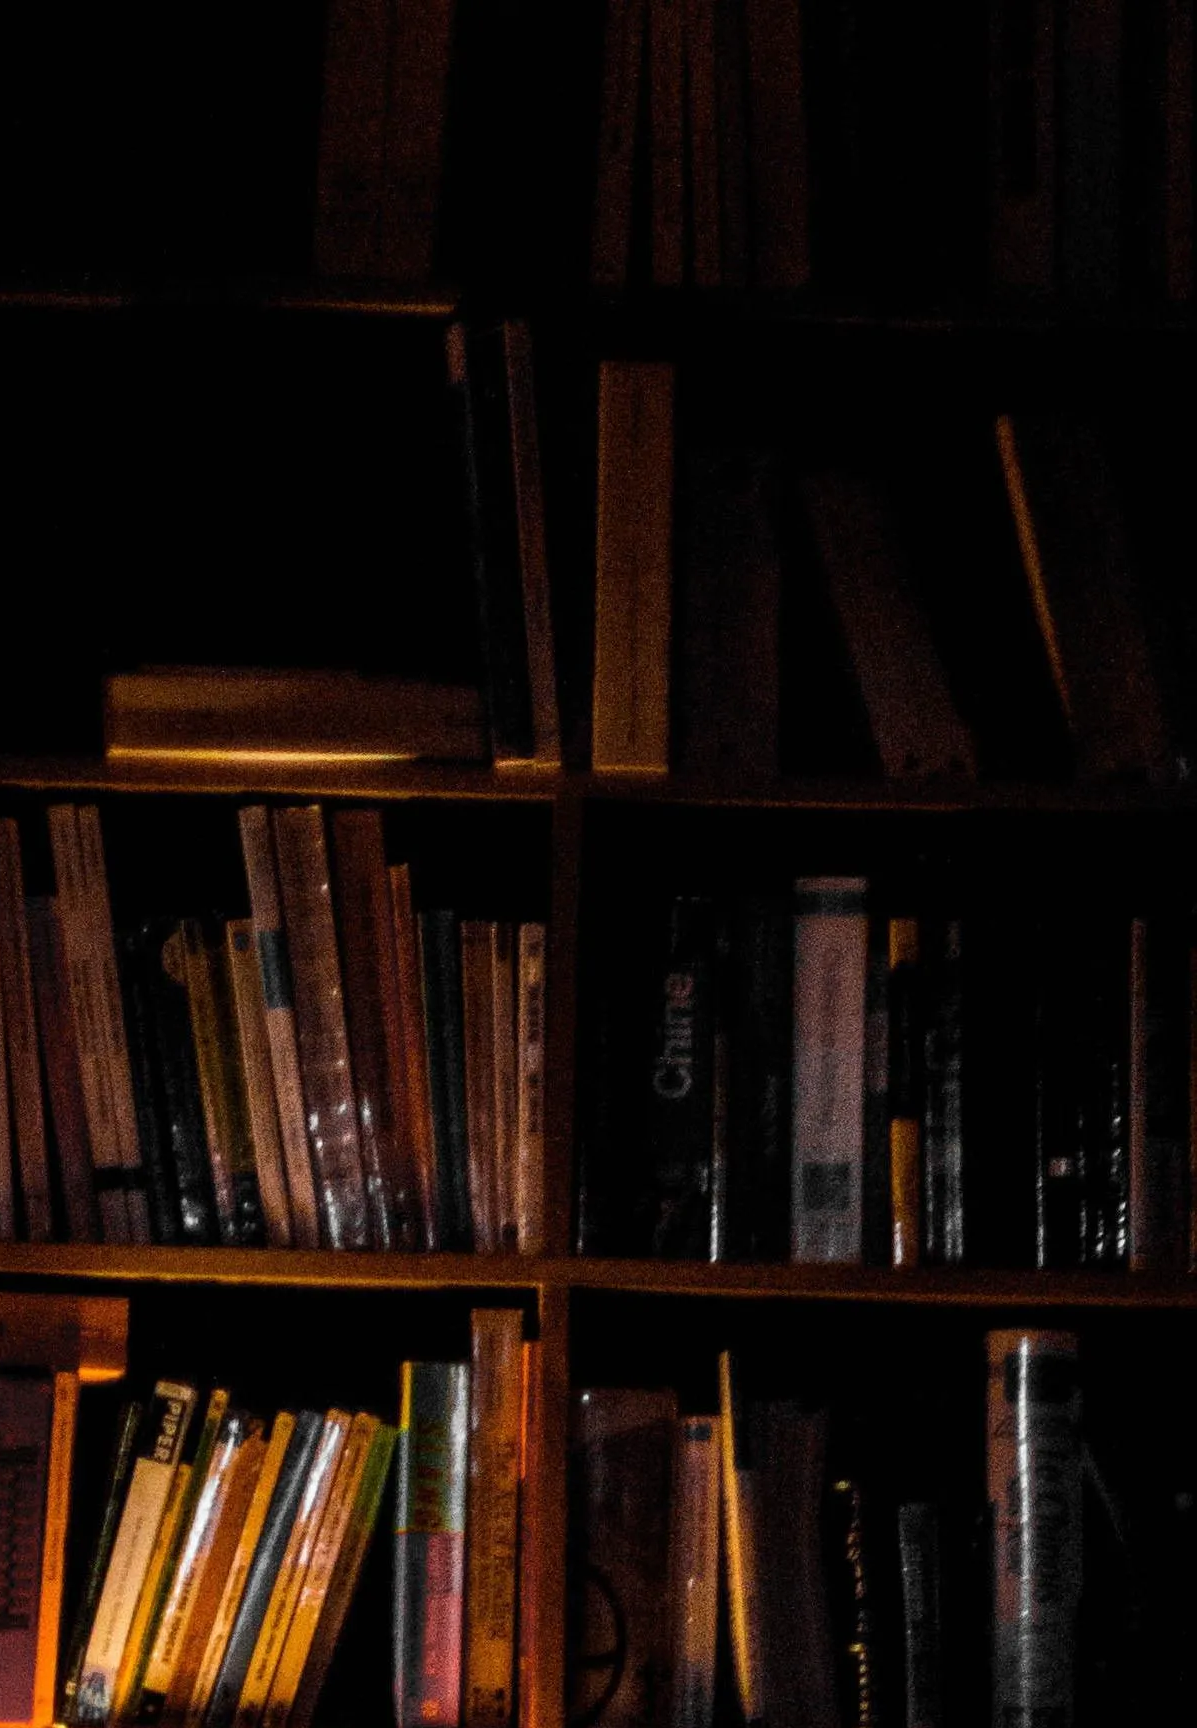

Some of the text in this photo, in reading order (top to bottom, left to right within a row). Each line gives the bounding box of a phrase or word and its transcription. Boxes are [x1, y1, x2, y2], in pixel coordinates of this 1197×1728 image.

[652, 972, 692, 1098] Chine
[154, 1400, 182, 1461] PIPER
[414, 1419, 443, 1530] SLANG
